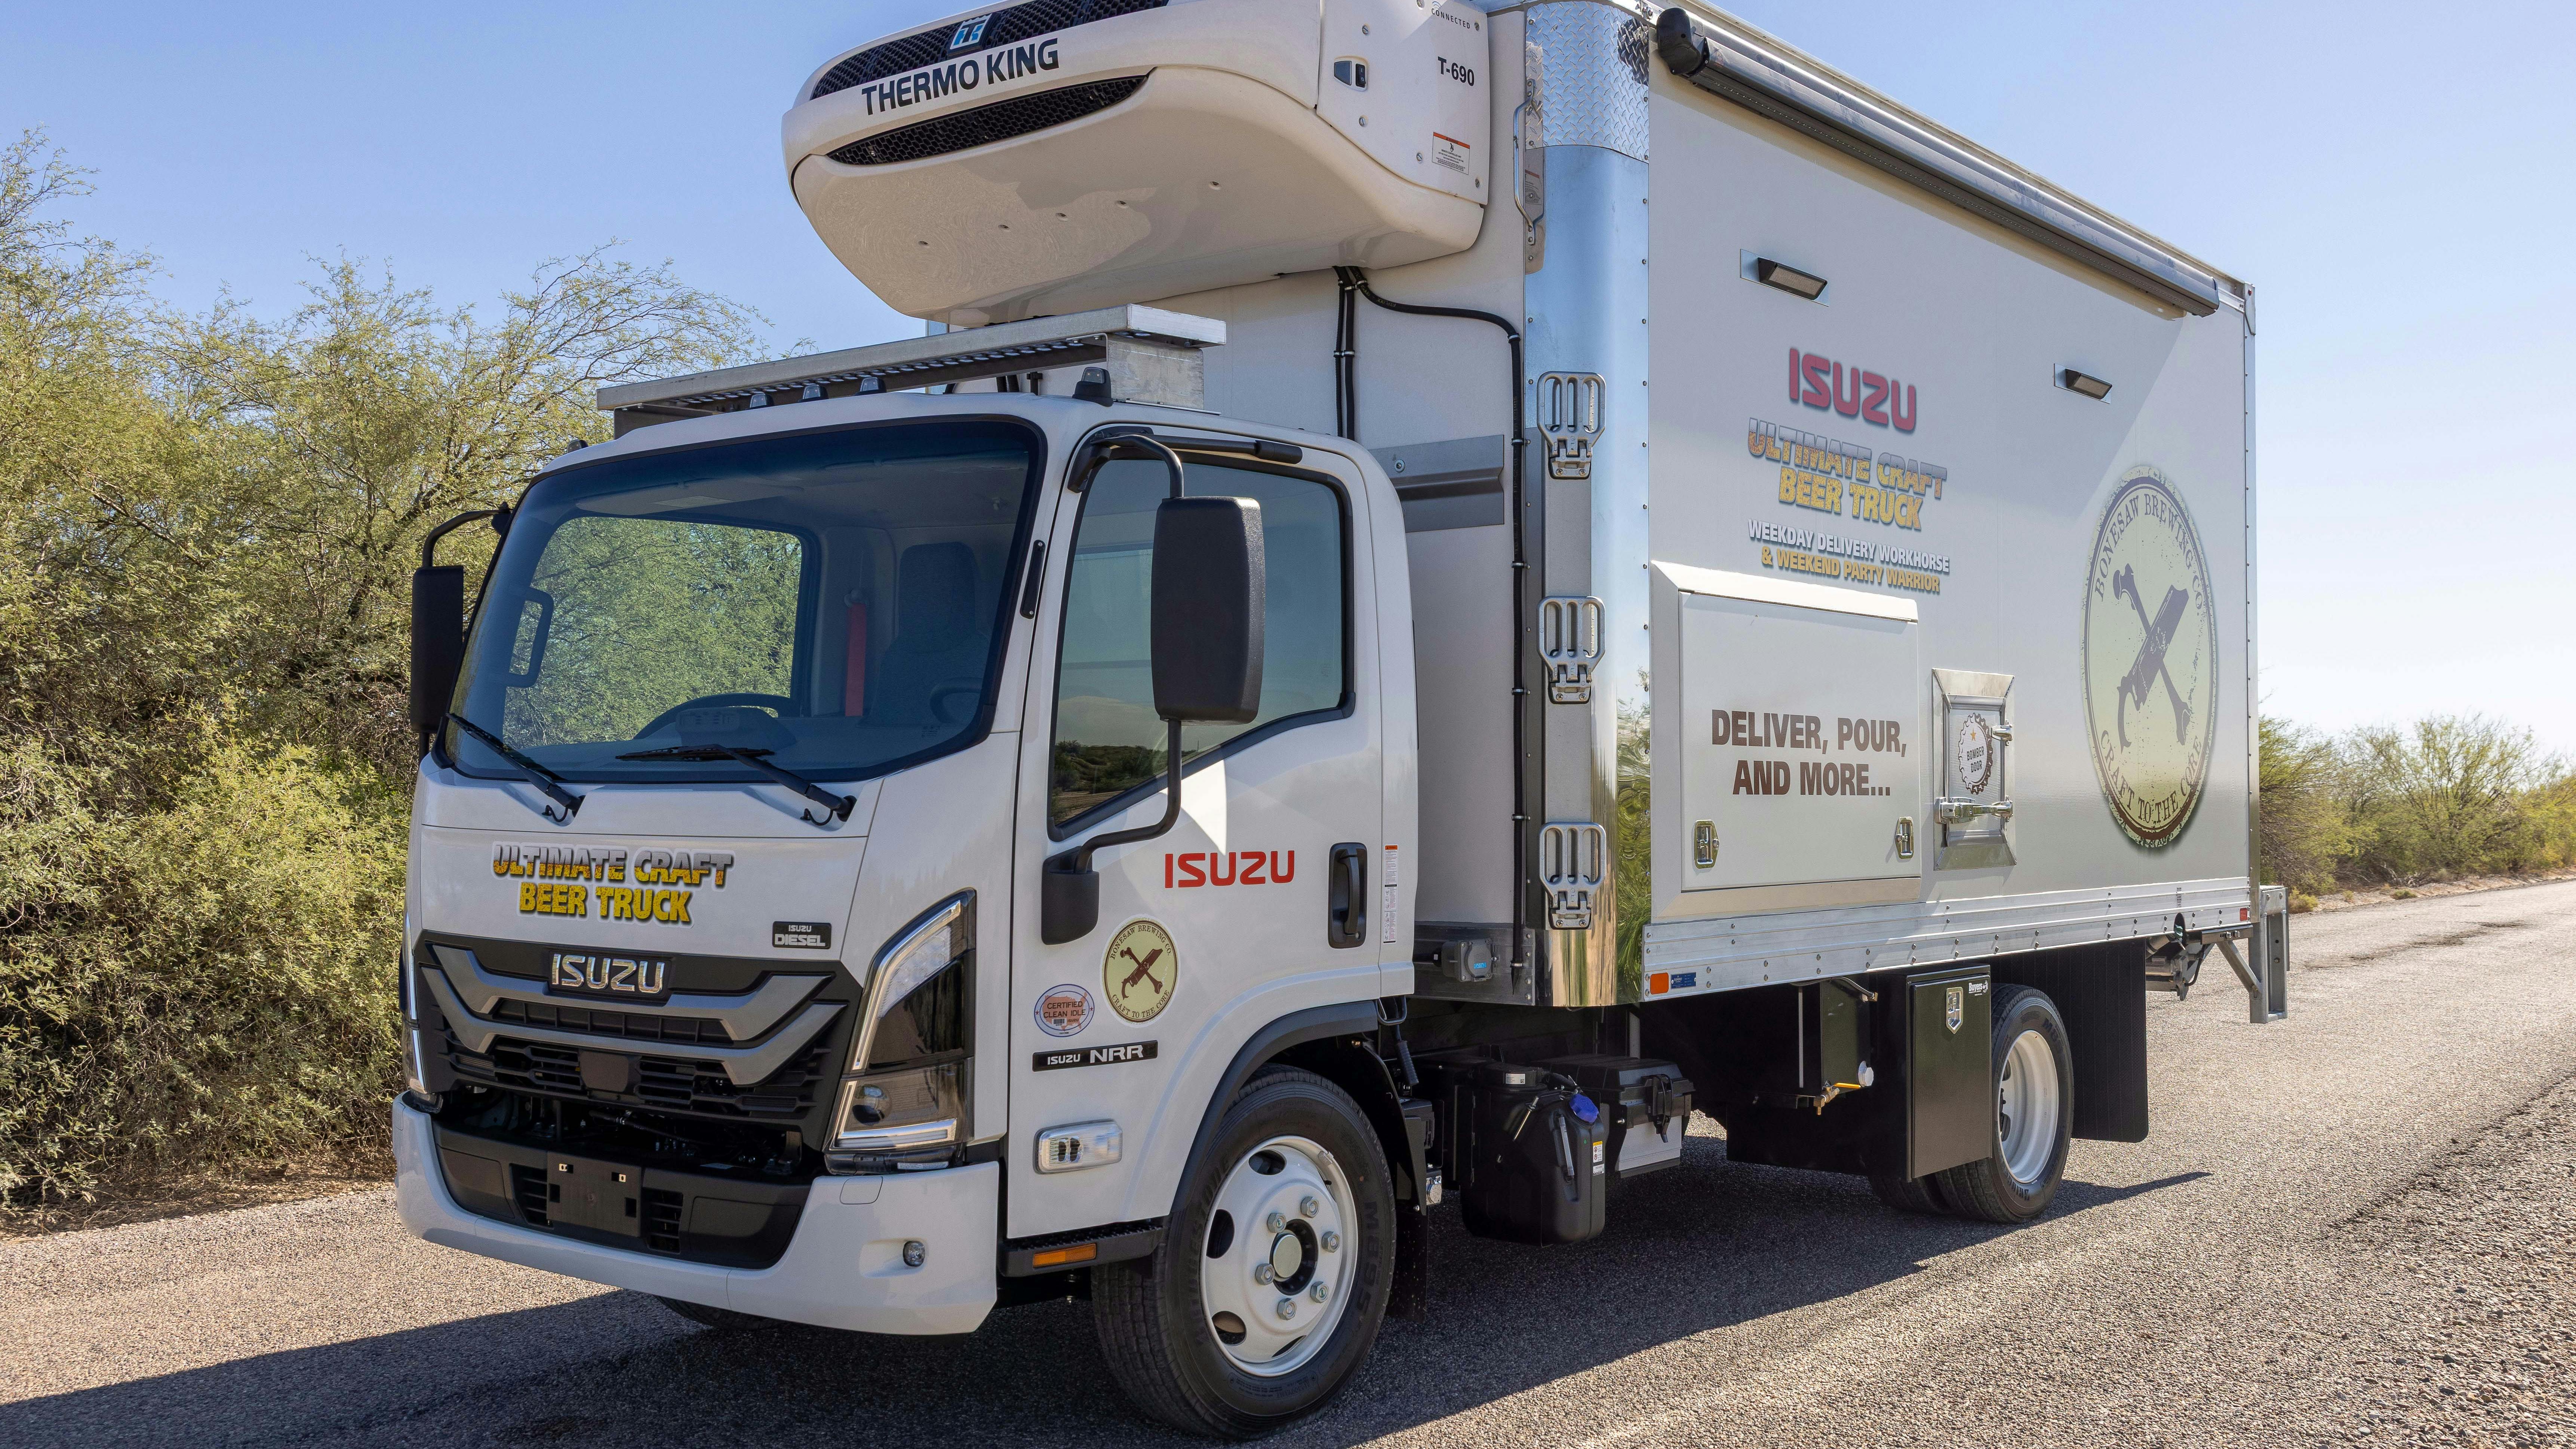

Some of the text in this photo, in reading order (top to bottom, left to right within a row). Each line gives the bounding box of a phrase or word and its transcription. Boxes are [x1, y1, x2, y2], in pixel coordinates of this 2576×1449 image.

[1431, 8, 1470, 29] CONNECTED
[861, 38, 1059, 116] THERMO KING
[1438, 56, 1475, 86] T-690
[1789, 347, 1916, 432] ISUZU
[1747, 417, 1947, 499] ULTIMATE CRAFT
[1779, 467, 1924, 530] BEER TRUCK
[1747, 519, 1950, 573] WEEKDAY DELIVERY WORKHORSE
[2094, 495, 2139, 602] BONESAW
[2143, 493, 2194, 571] BREWING
[1761, 546, 1940, 593] & WEEKEND PARTY WARRIOR
[1712, 709, 1907, 758] DELIVER, POUR,
[1967, 746, 1985, 761] BOMBER
[1733, 760, 1891, 797] AND MORE...
[1971, 760, 1982, 773] DOOR
[2101, 728, 2203, 824] CRAFT TO THE CORE
[492, 844, 734, 887] ULTIMATE CRAFT
[1165, 850, 1295, 888] ISUZU
[519, 882, 693, 924] BEER TRUCK
[774, 933, 826, 946] DIESEL
[1110, 927, 1136, 960] BONESAW
[1138, 925, 1166, 943] BREWING
[551, 953, 666, 994] ISUZU
[1968, 982, 1983, 993] Buyers
[1112, 994, 1131, 1015] CRAFT
[1141, 1008, 1155, 1018] THE
[1156, 989, 1169, 1009] CORE
[1047, 1044, 1144, 1065] ISUZU NRR
